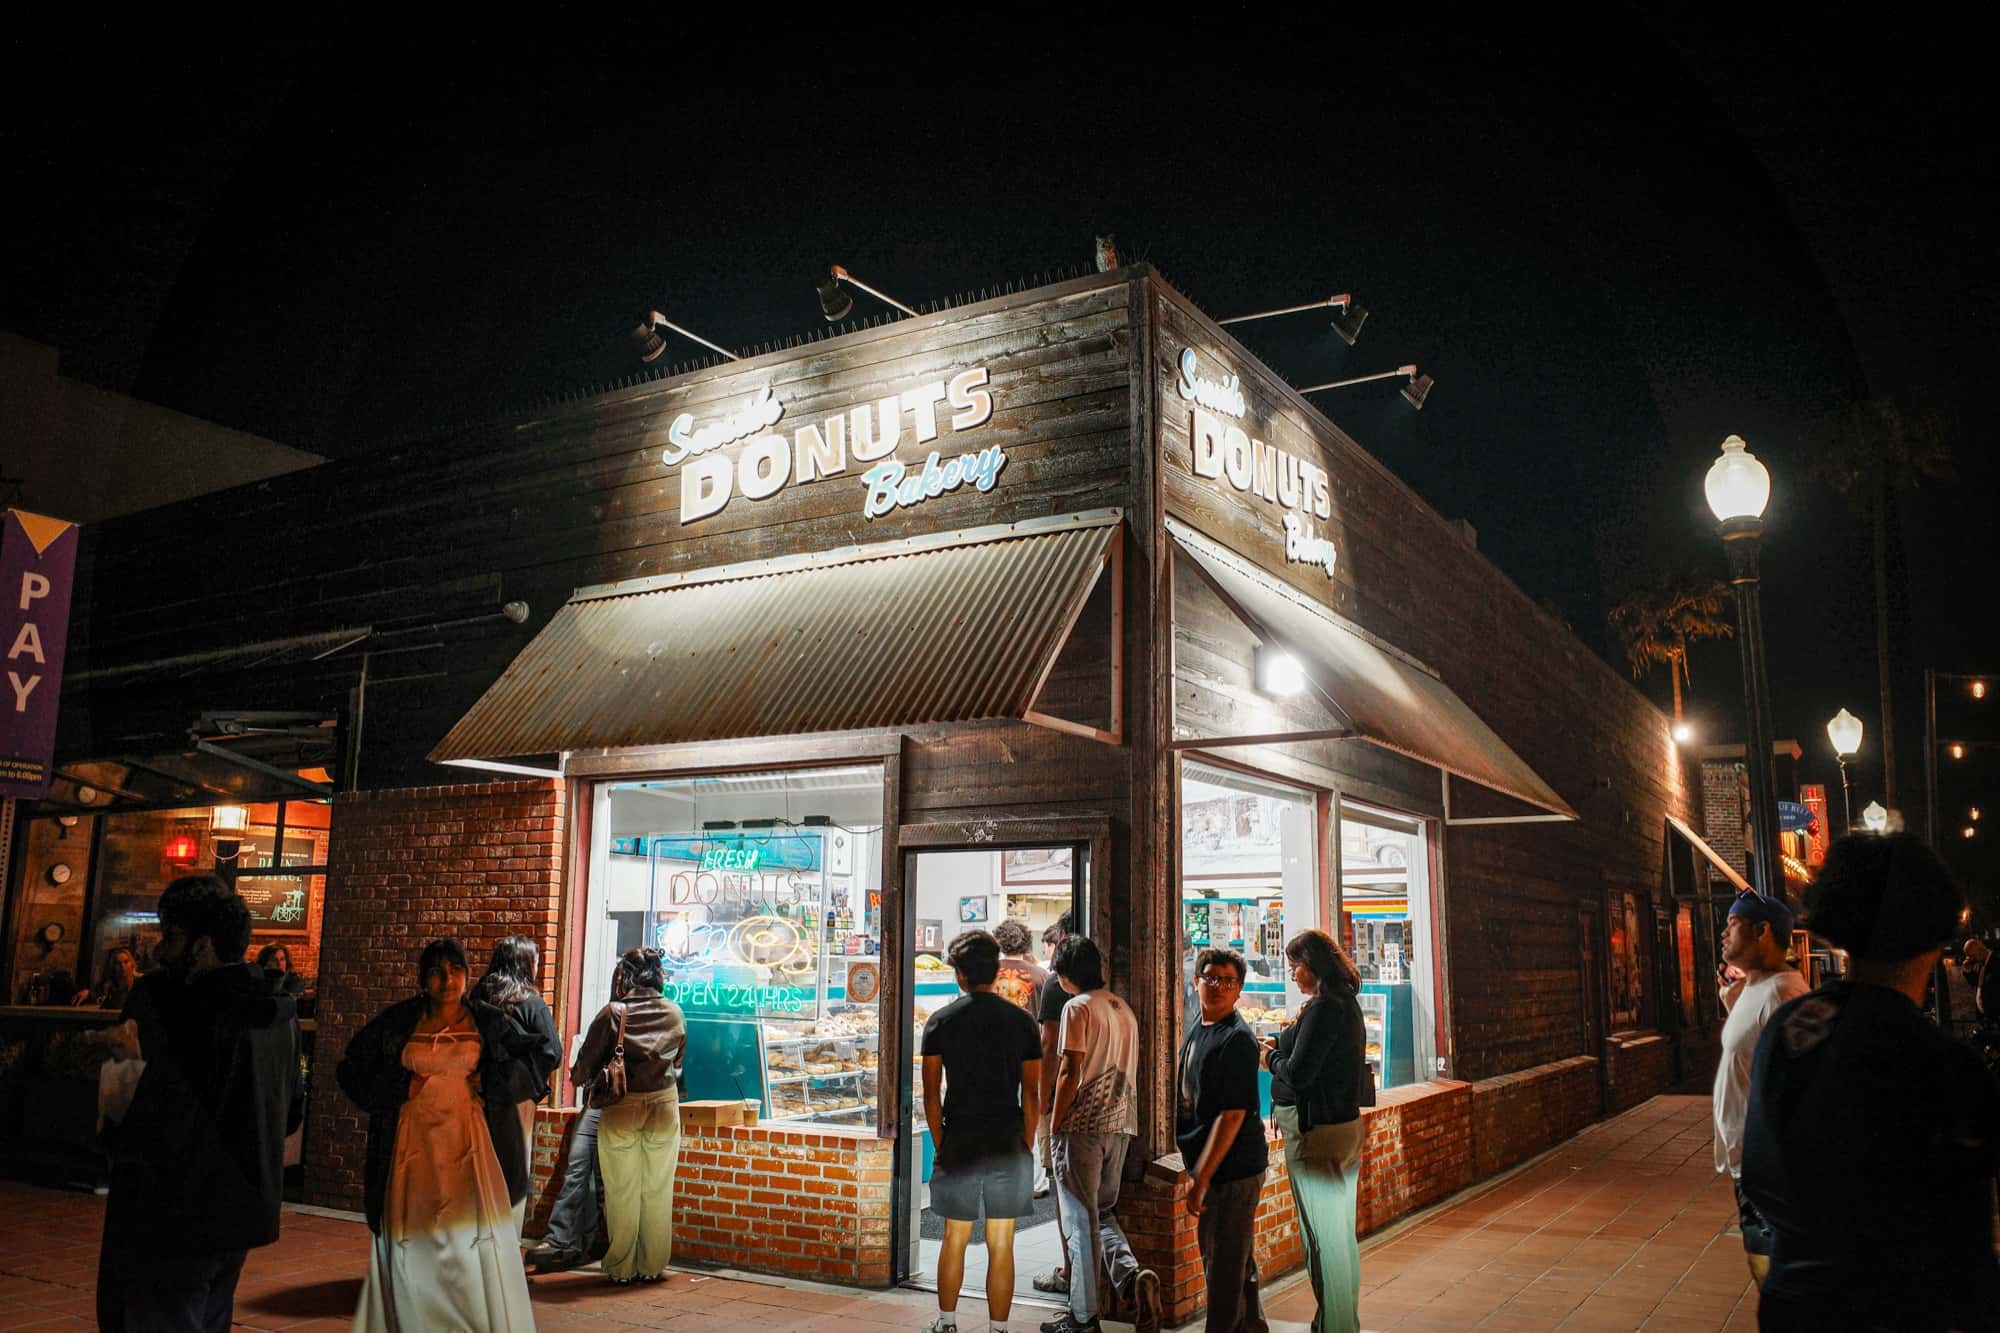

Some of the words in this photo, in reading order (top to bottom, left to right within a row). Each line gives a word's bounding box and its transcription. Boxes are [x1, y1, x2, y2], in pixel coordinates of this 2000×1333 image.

[680, 367, 993, 526] DONUTS
[862, 445, 1007, 520] Bakery
[1193, 407, 1331, 520] DONUTS
[8, 571, 50, 712] PAY
[671, 872, 802, 906] DONUTS
[704, 849, 759, 870] FRESH
[662, 981, 720, 1006] OPEN
[727, 984, 756, 1008] 24
[760, 986, 803, 1012] HRS
